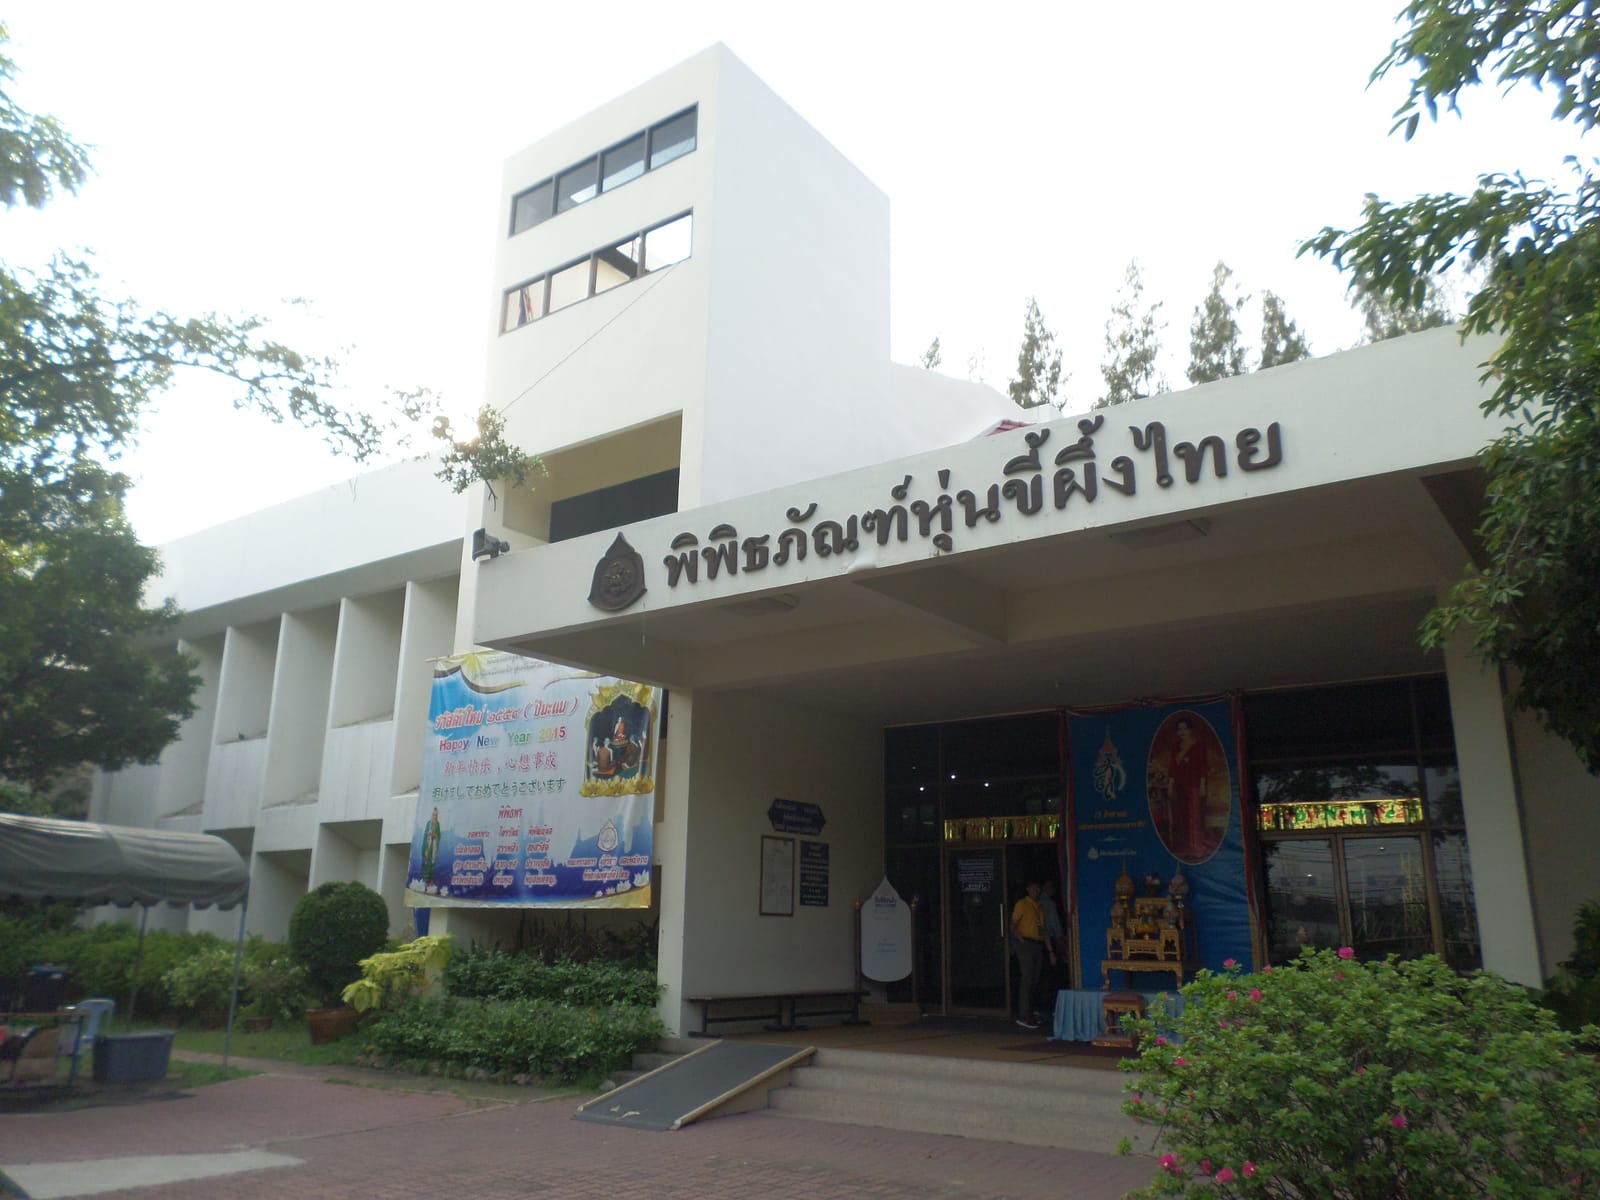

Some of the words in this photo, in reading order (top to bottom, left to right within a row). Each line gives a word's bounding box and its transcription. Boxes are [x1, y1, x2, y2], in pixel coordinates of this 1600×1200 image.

[663, 415, 1282, 588] พิพิธภัณฑ์หุ่นขี้ผึ้งไทย
[440, 739, 470, 752] Happy
[477, 735, 498, 747] New
[508, 730, 532, 744] Year
[539, 726, 567, 741] 2015
